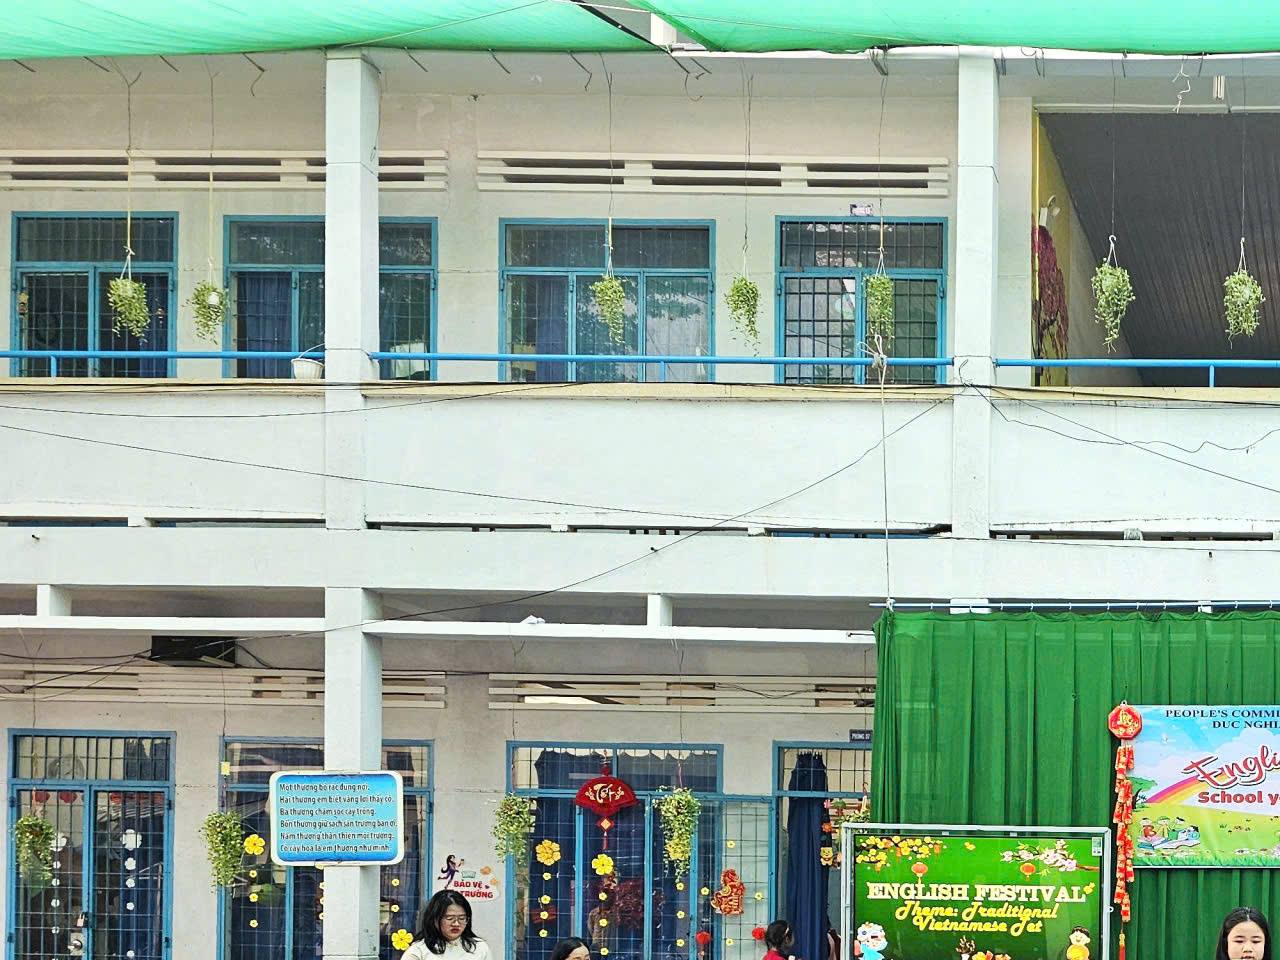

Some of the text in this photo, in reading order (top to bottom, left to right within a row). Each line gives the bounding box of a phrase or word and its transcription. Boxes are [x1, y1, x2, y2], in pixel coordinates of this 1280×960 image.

[1166, 709, 1228, 718] PEOPLE'S
[1212, 720, 1240, 729] DUC
[1198, 791, 1264, 804] School
[866, 881, 1086, 902] ENGLISH FESTIVAL
[895, 900, 1059, 922] Theme: Traditional
[912, 915, 1043, 937] Vietnamese Tet
